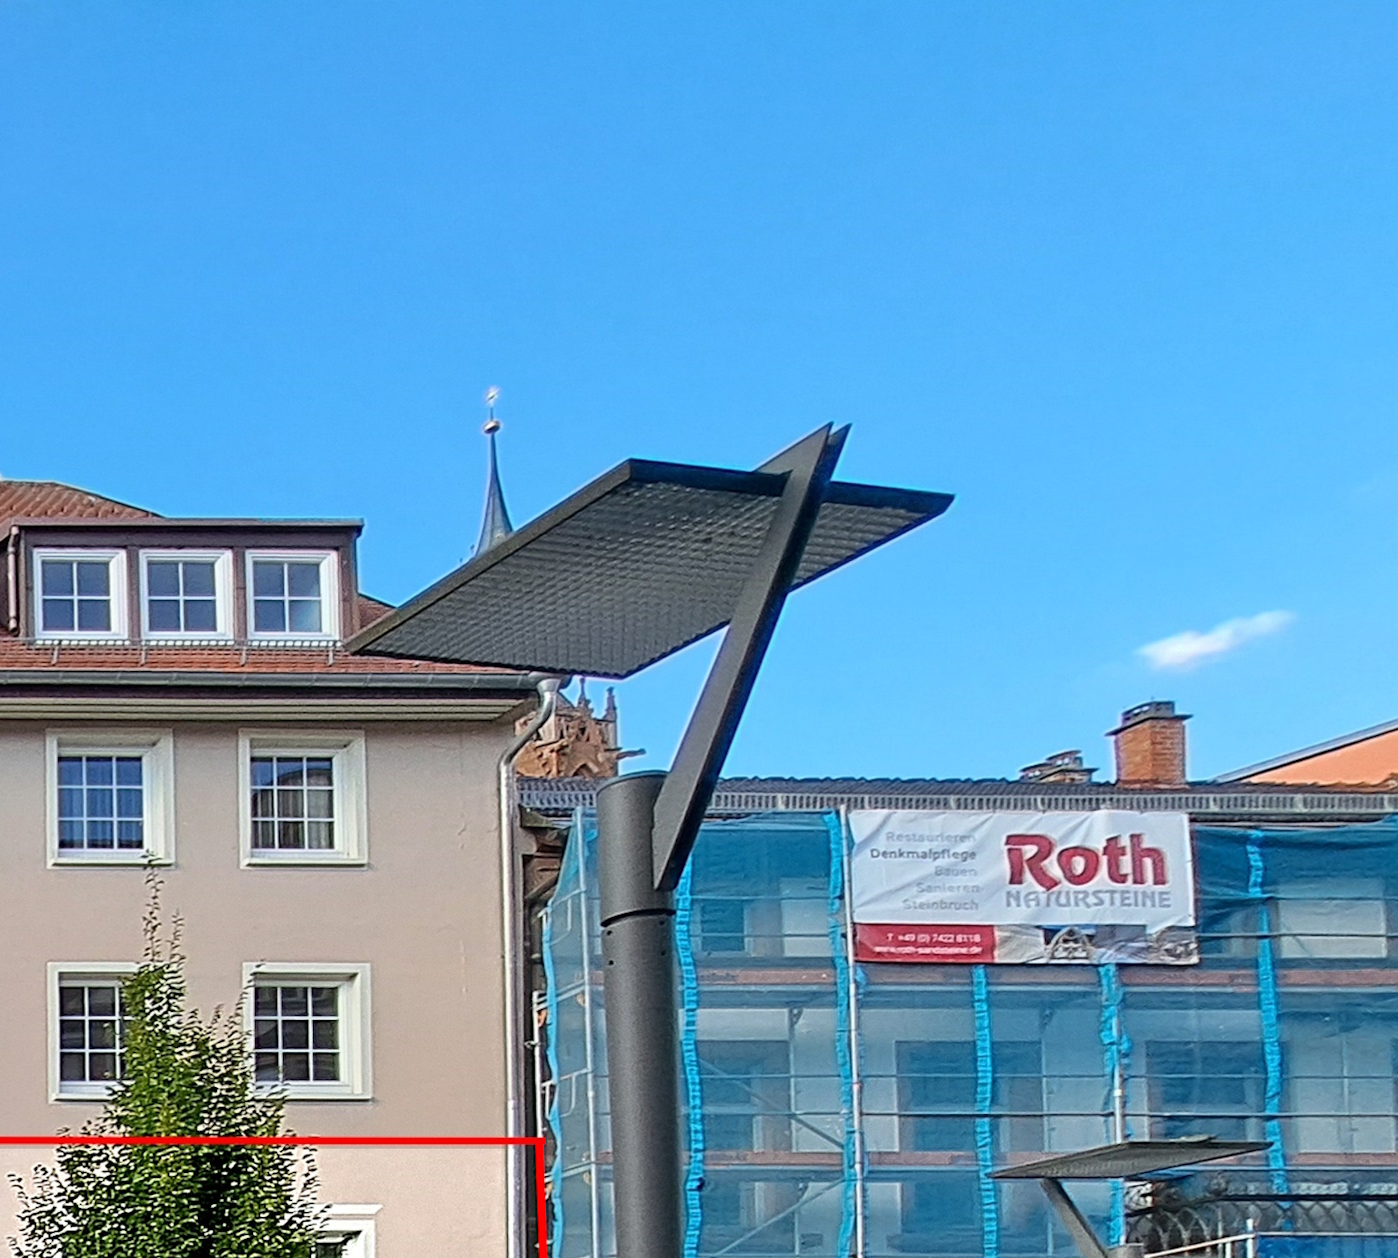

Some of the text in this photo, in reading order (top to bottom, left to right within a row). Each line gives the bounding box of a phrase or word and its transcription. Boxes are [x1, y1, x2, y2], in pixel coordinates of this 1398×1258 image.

[885, 832, 977, 843] Restaurieren
[870, 848, 977, 862] Denkmalpflege
[1004, 833, 1167, 891] Roth
[934, 866, 977, 877] Bauen
[916, 882, 980, 893] Sanieren
[902, 899, 979, 911] Steinbruch
[1006, 889, 1172, 909] NATURSTEINE
